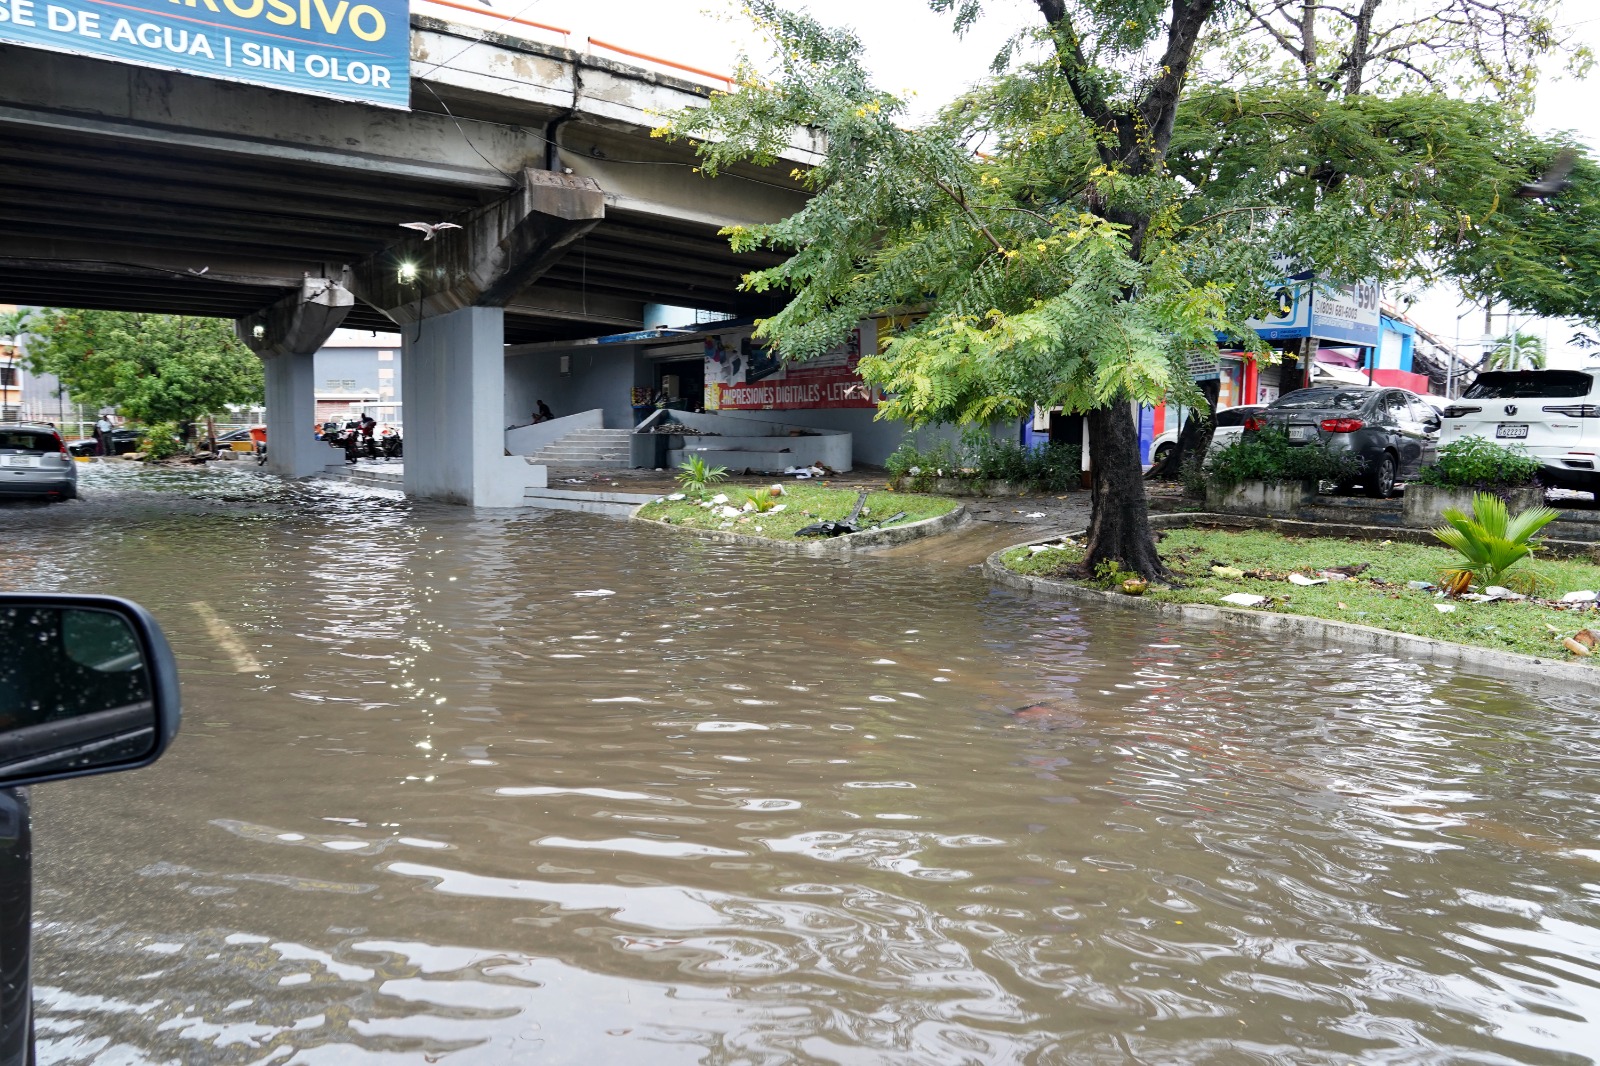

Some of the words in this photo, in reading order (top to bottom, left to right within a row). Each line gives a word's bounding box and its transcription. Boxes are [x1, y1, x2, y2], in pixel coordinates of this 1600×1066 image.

[169, 0, 386, 42] SIVO
[47, 4, 101, 39] DE
[110, 18, 215, 60] AGUA
[241, 42, 295, 73] SIN
[304, 54, 391, 89] OLOR
[722, 386, 774, 405] IMPRESIONES
[775, 383, 820, 403] DIGITALES
[827, 381, 870, 400] LETRER
